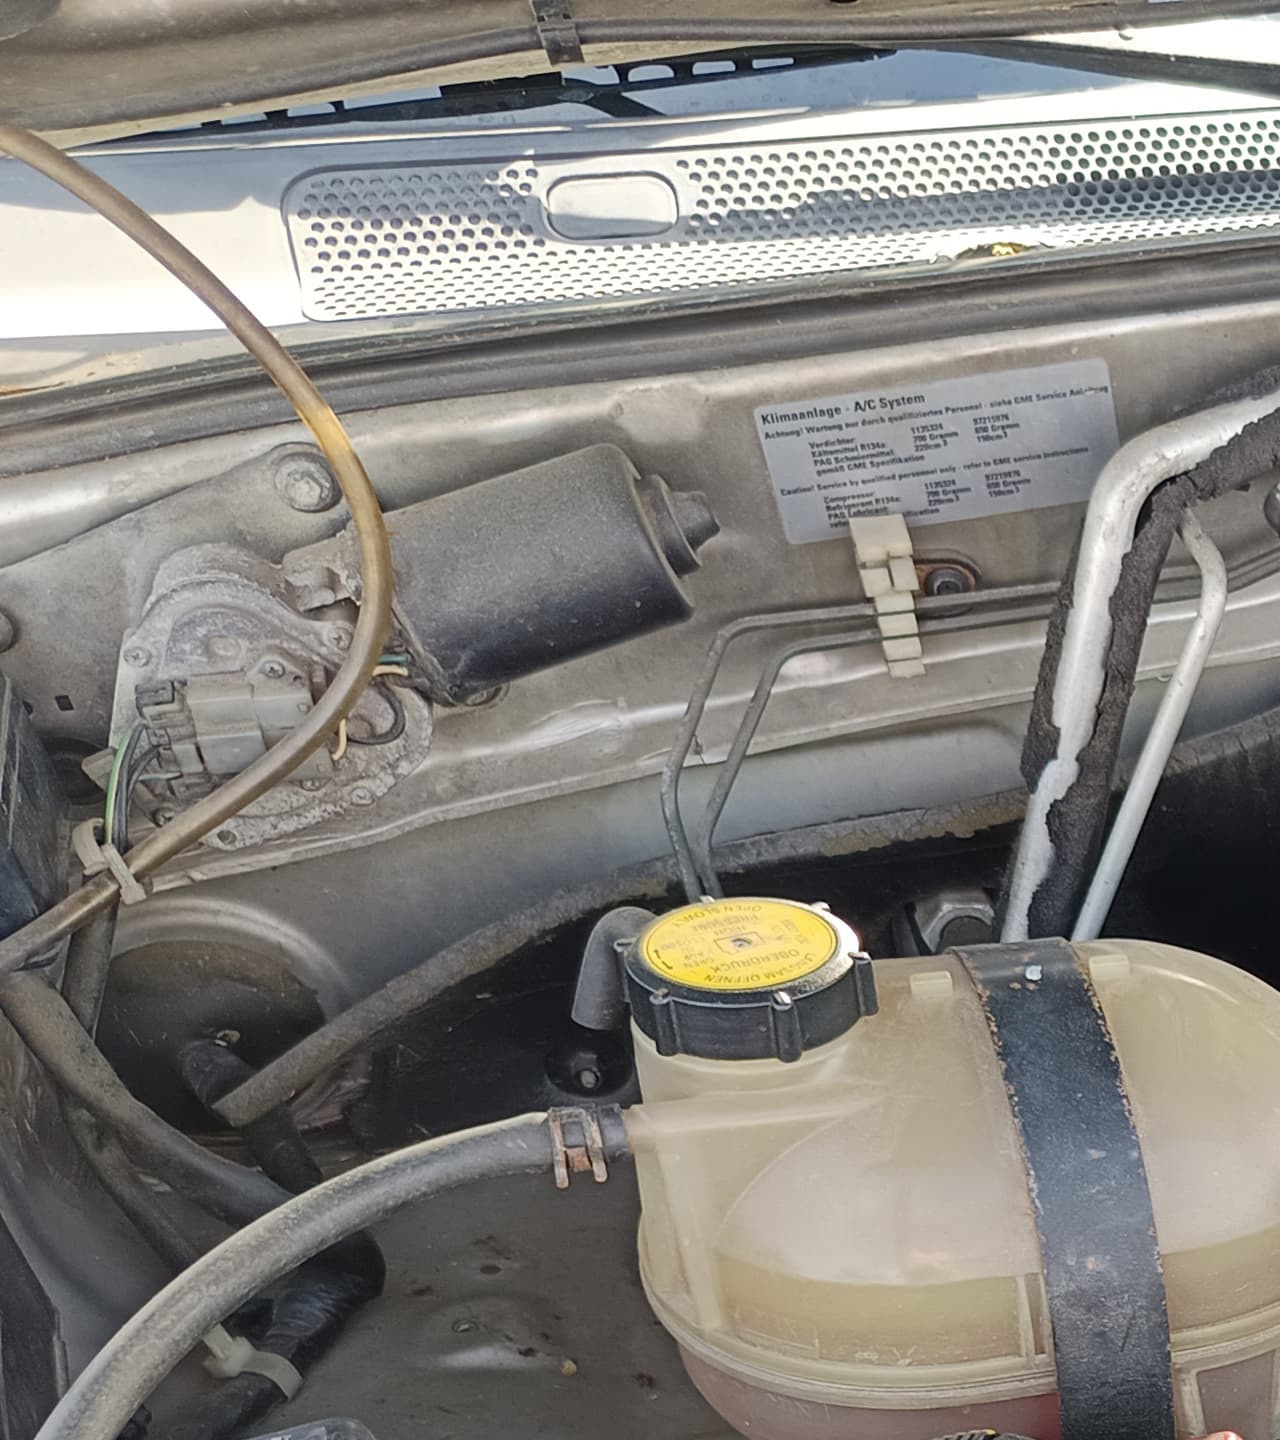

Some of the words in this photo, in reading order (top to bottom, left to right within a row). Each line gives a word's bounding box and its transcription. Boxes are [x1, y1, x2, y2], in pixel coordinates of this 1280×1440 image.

[761, 405, 841, 425] Klimaanlage
[854, 400, 876, 412] A/C
[880, 395, 925, 410] System
[764, 428, 803, 439] Achtung!
[805, 422, 843, 434] Wartung
[861, 416, 885, 427] durch
[945, 402, 982, 414] Personal
[1036, 391, 1067, 401] Service
[817, 481, 847, 490] Service
